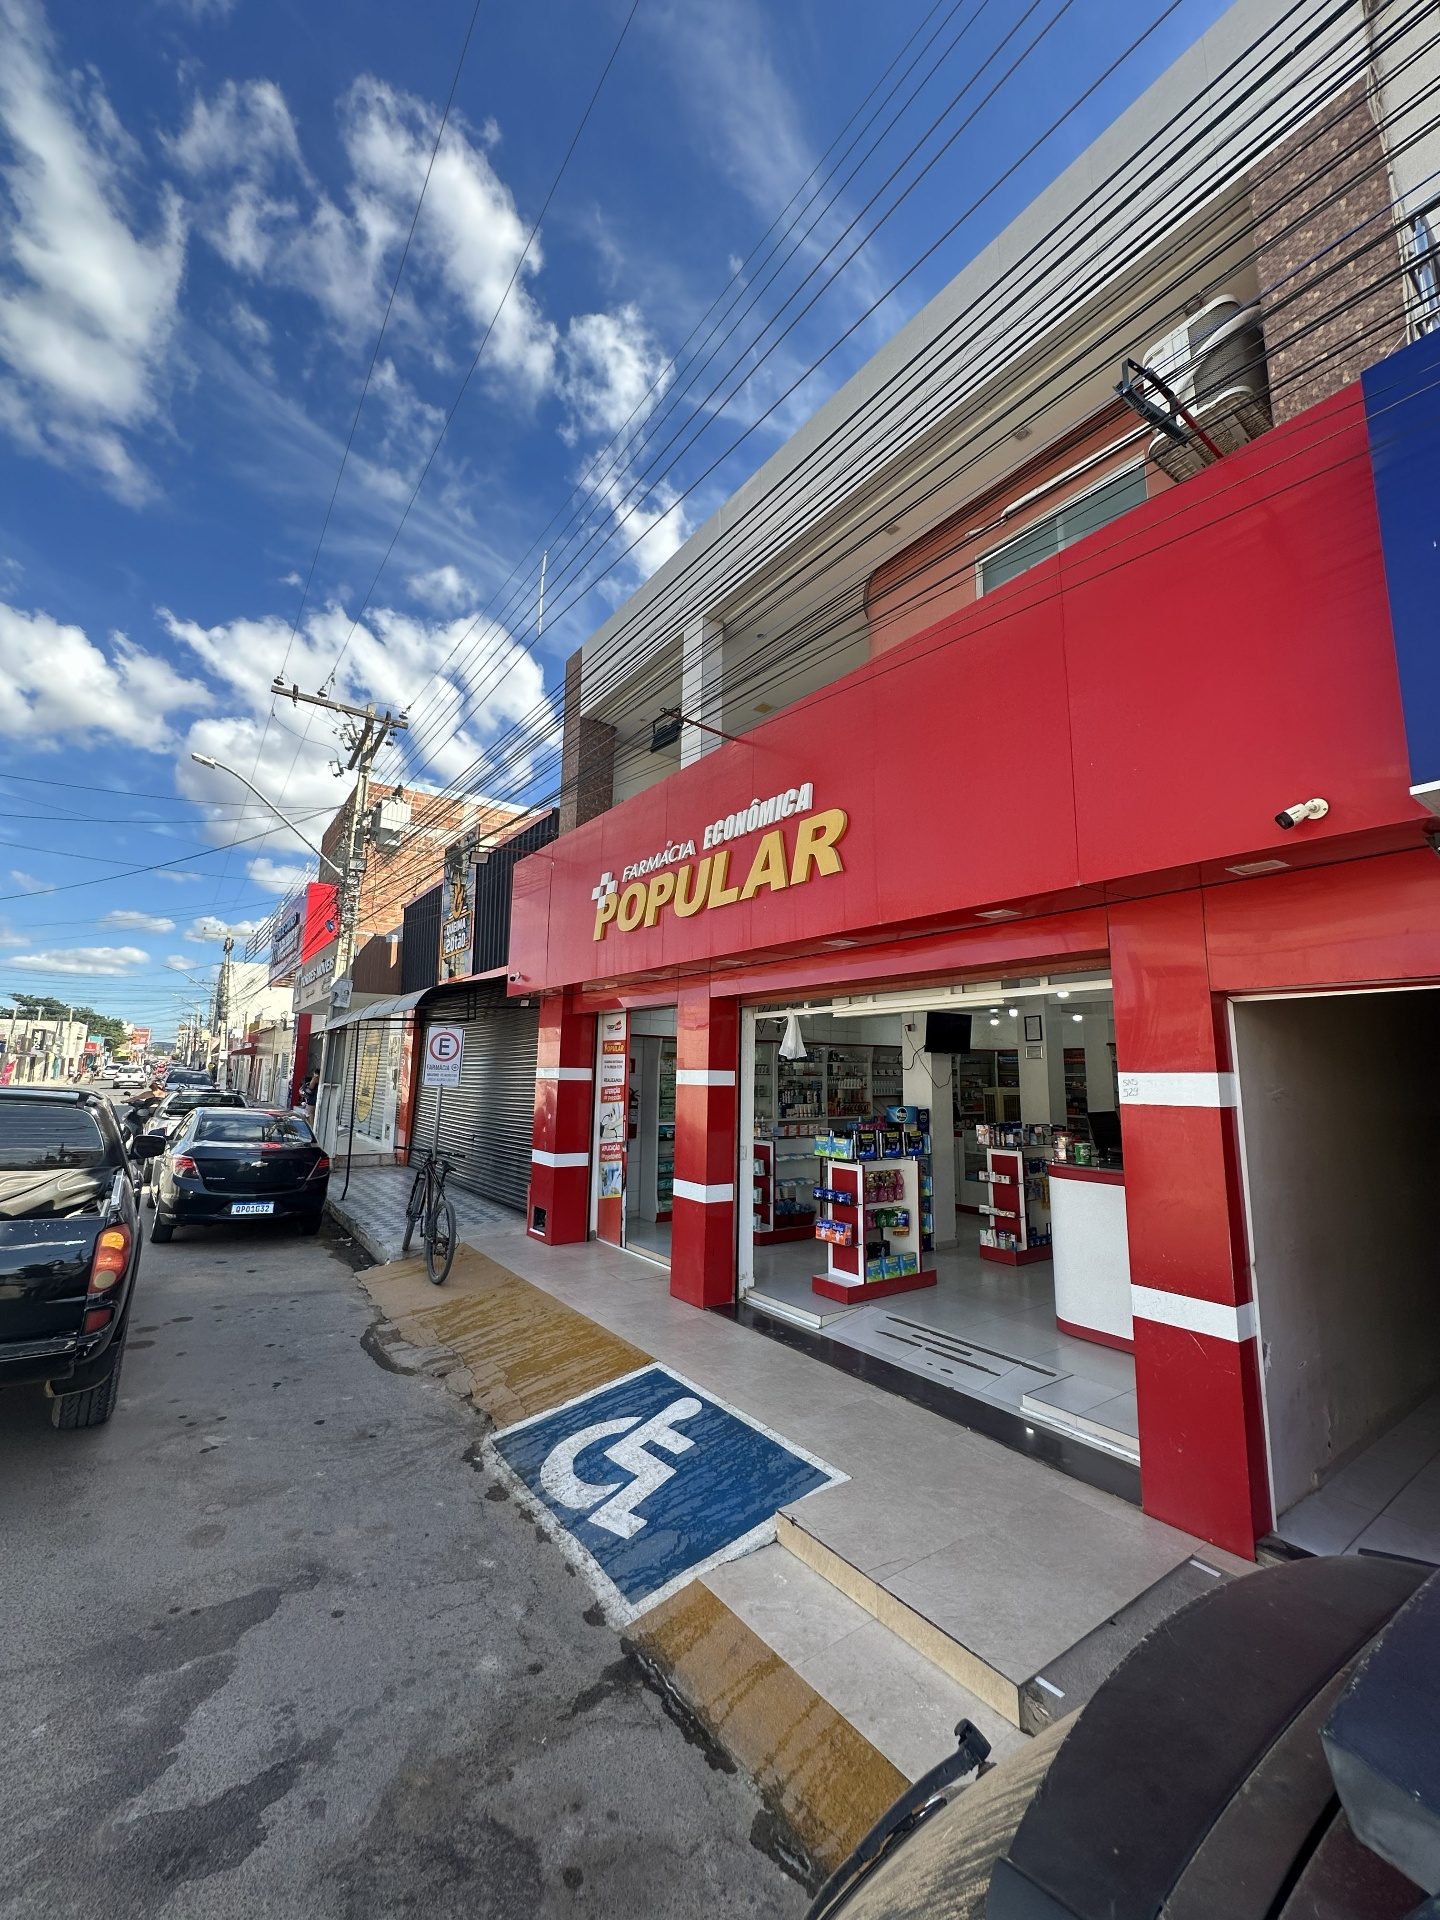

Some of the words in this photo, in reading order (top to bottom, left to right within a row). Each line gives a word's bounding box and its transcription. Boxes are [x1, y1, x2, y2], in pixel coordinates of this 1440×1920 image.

[621, 839, 696, 883] FARMÁCIA
[702, 782, 813, 850] ECONÔMICA
[592, 808, 848, 941] POPULAR
[439, 1037, 451, 1056] E
[604, 1043, 625, 1052] POPULAR
